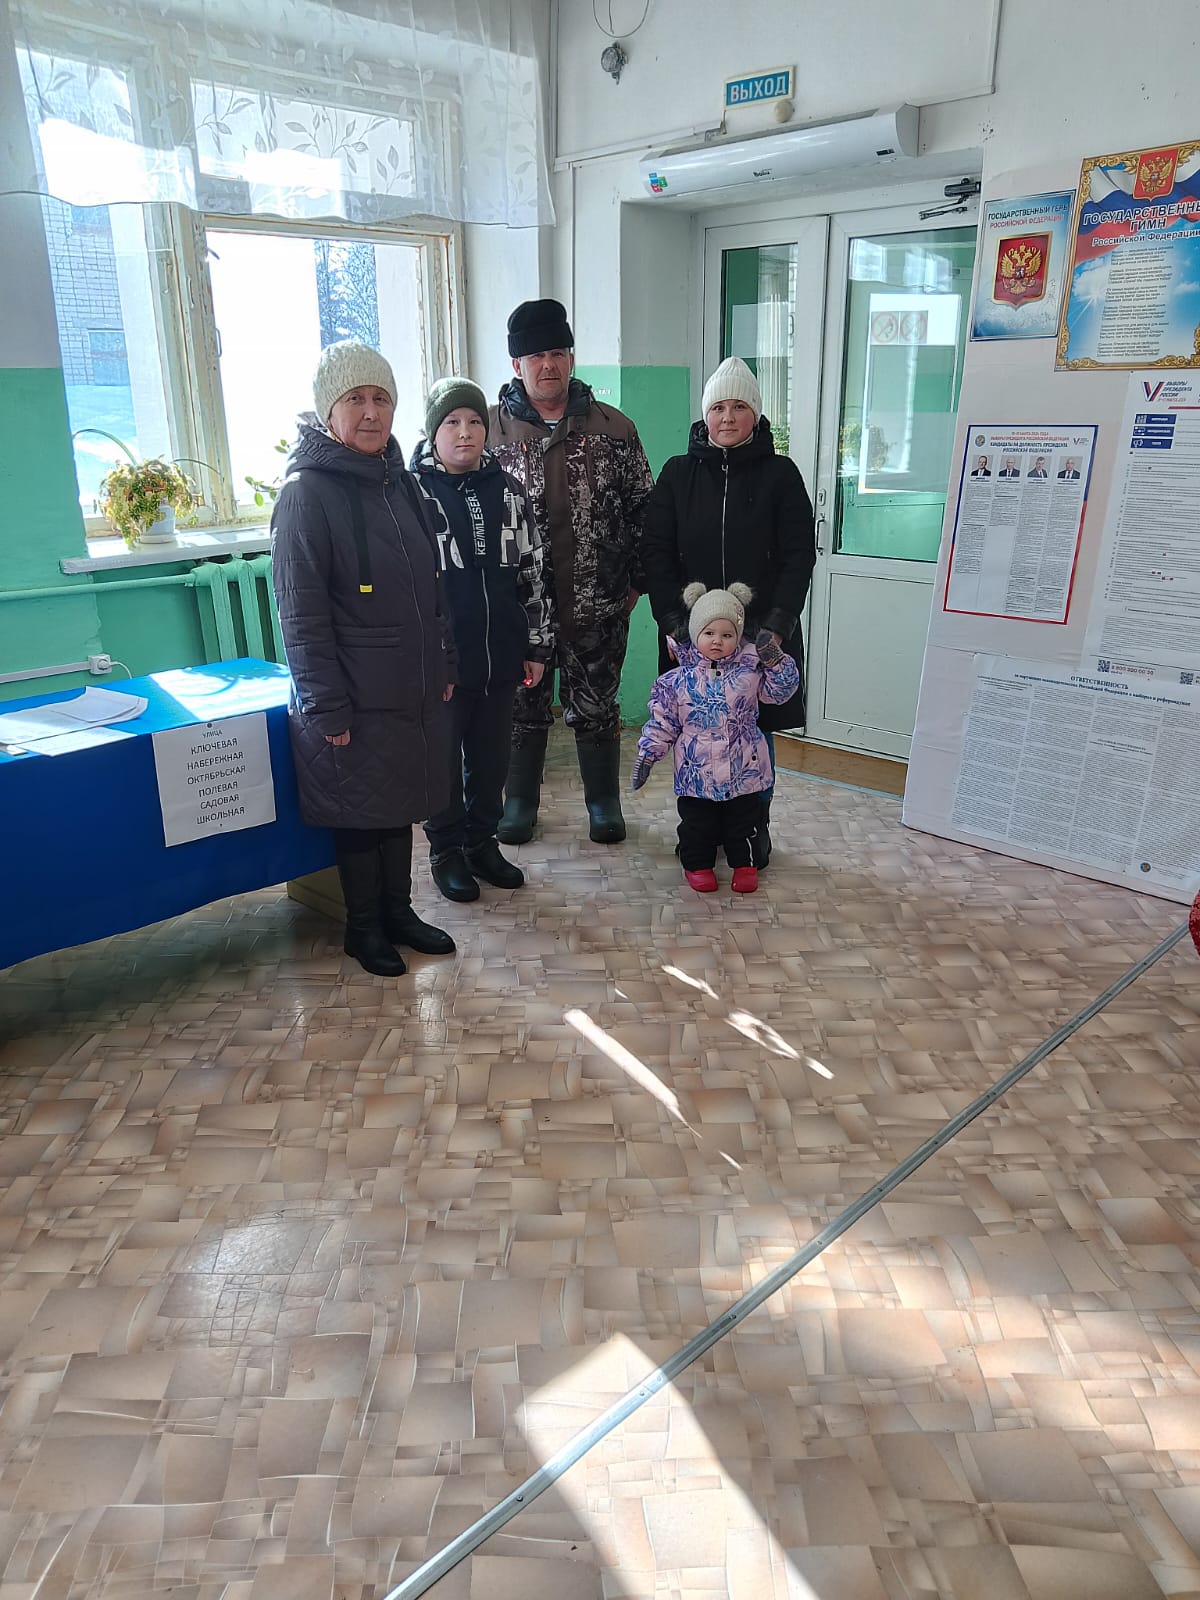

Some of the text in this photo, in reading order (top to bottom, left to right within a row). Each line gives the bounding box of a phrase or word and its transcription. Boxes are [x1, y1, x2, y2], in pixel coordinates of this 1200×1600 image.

[730, 76, 787, 103] ВЫХОД
[988, 204, 1068, 220] ГОСУДАРСТВЕННЫЙ ГЕРБ
[990, 214, 1064, 229] РОССИЙСКОЙ ФЕДЕРАЦИИ
[1130, 217, 1167, 232] ГИМН
[1092, 234, 1145, 247] Российской
[1070, 675, 1129, 690] ОТВЕТСТВЕННОСТЬ
[202, 730, 223, 739] УЛИЦА
[190, 738, 238, 755] КЛЮЧЕВАЯ
[187, 751, 244, 771] НАБЕРЕЖНАЯ
[187, 765, 246, 785] ОКТЯБРЬСКАЯ
[198, 781, 238, 798] ПОЛЕВАЯ
[200, 794, 240, 810] САДОВАЯ
[196, 806, 245, 825] ШКОЛЬНАЯ
